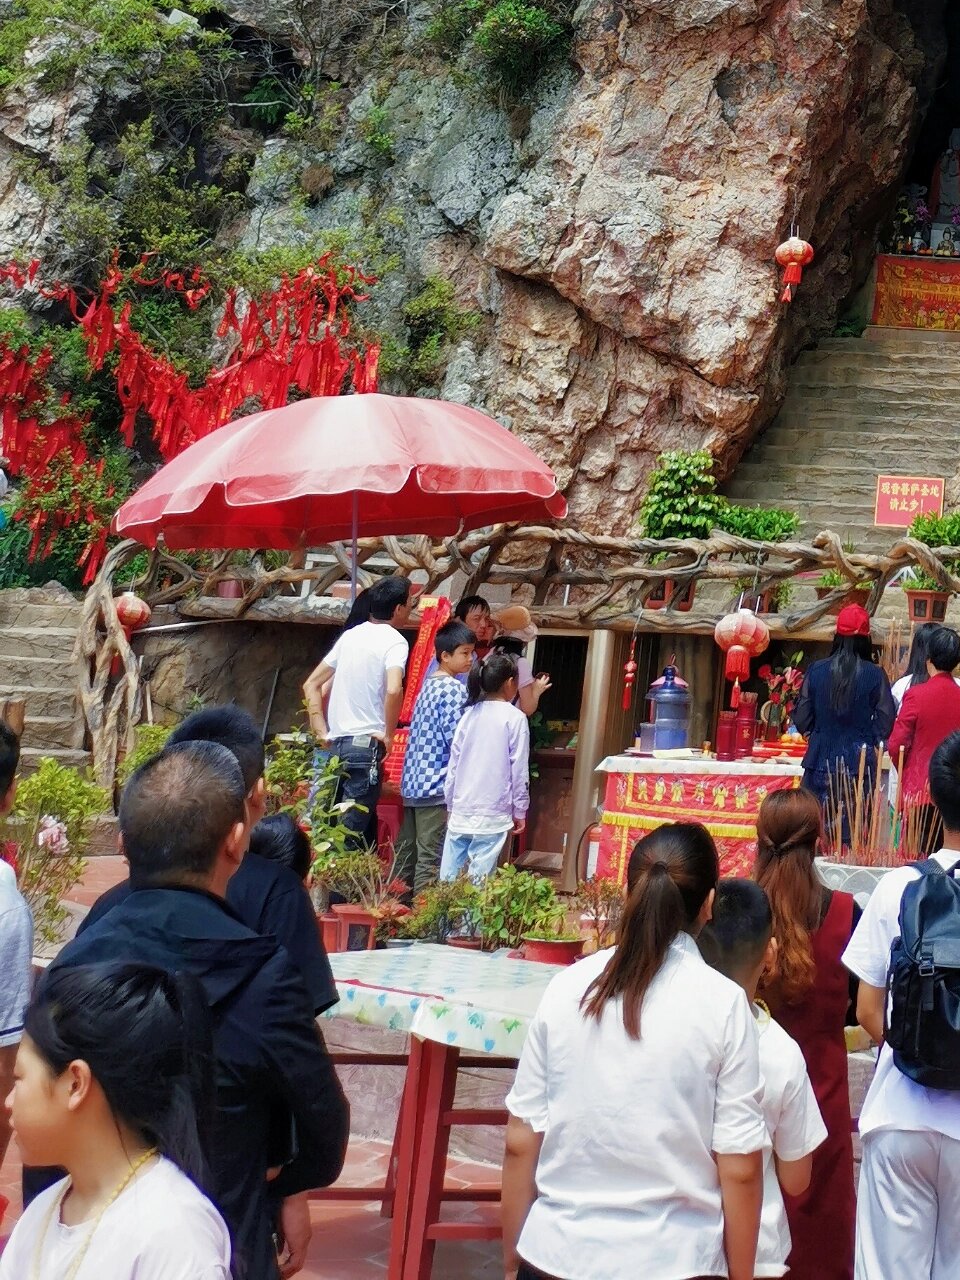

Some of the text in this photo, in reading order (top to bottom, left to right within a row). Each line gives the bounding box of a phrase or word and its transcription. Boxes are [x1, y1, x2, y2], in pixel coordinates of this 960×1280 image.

[880, 481, 940, 498] 观音菩萨圣地
